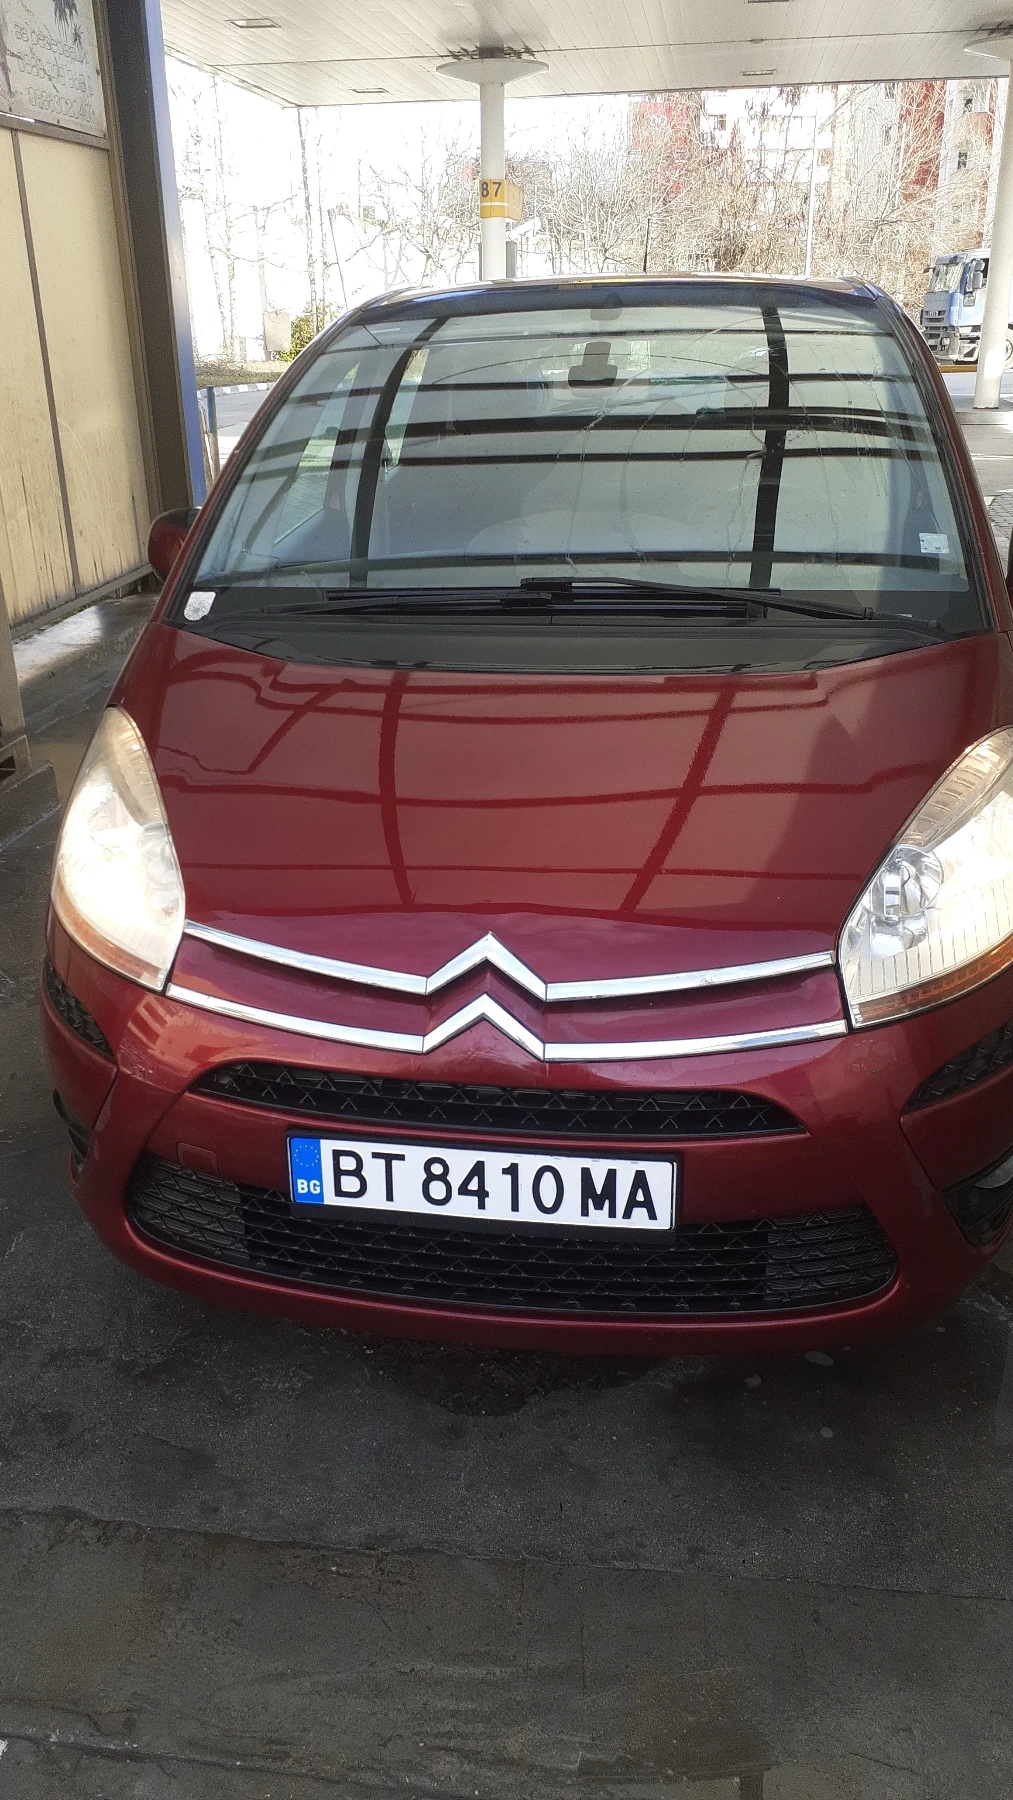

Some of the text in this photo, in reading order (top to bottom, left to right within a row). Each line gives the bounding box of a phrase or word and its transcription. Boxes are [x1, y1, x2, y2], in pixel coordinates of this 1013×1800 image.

[481, 182, 502, 197] 87
[297, 1178, 321, 1194] BG
[332, 1149, 658, 1221] BT 8410 MA
